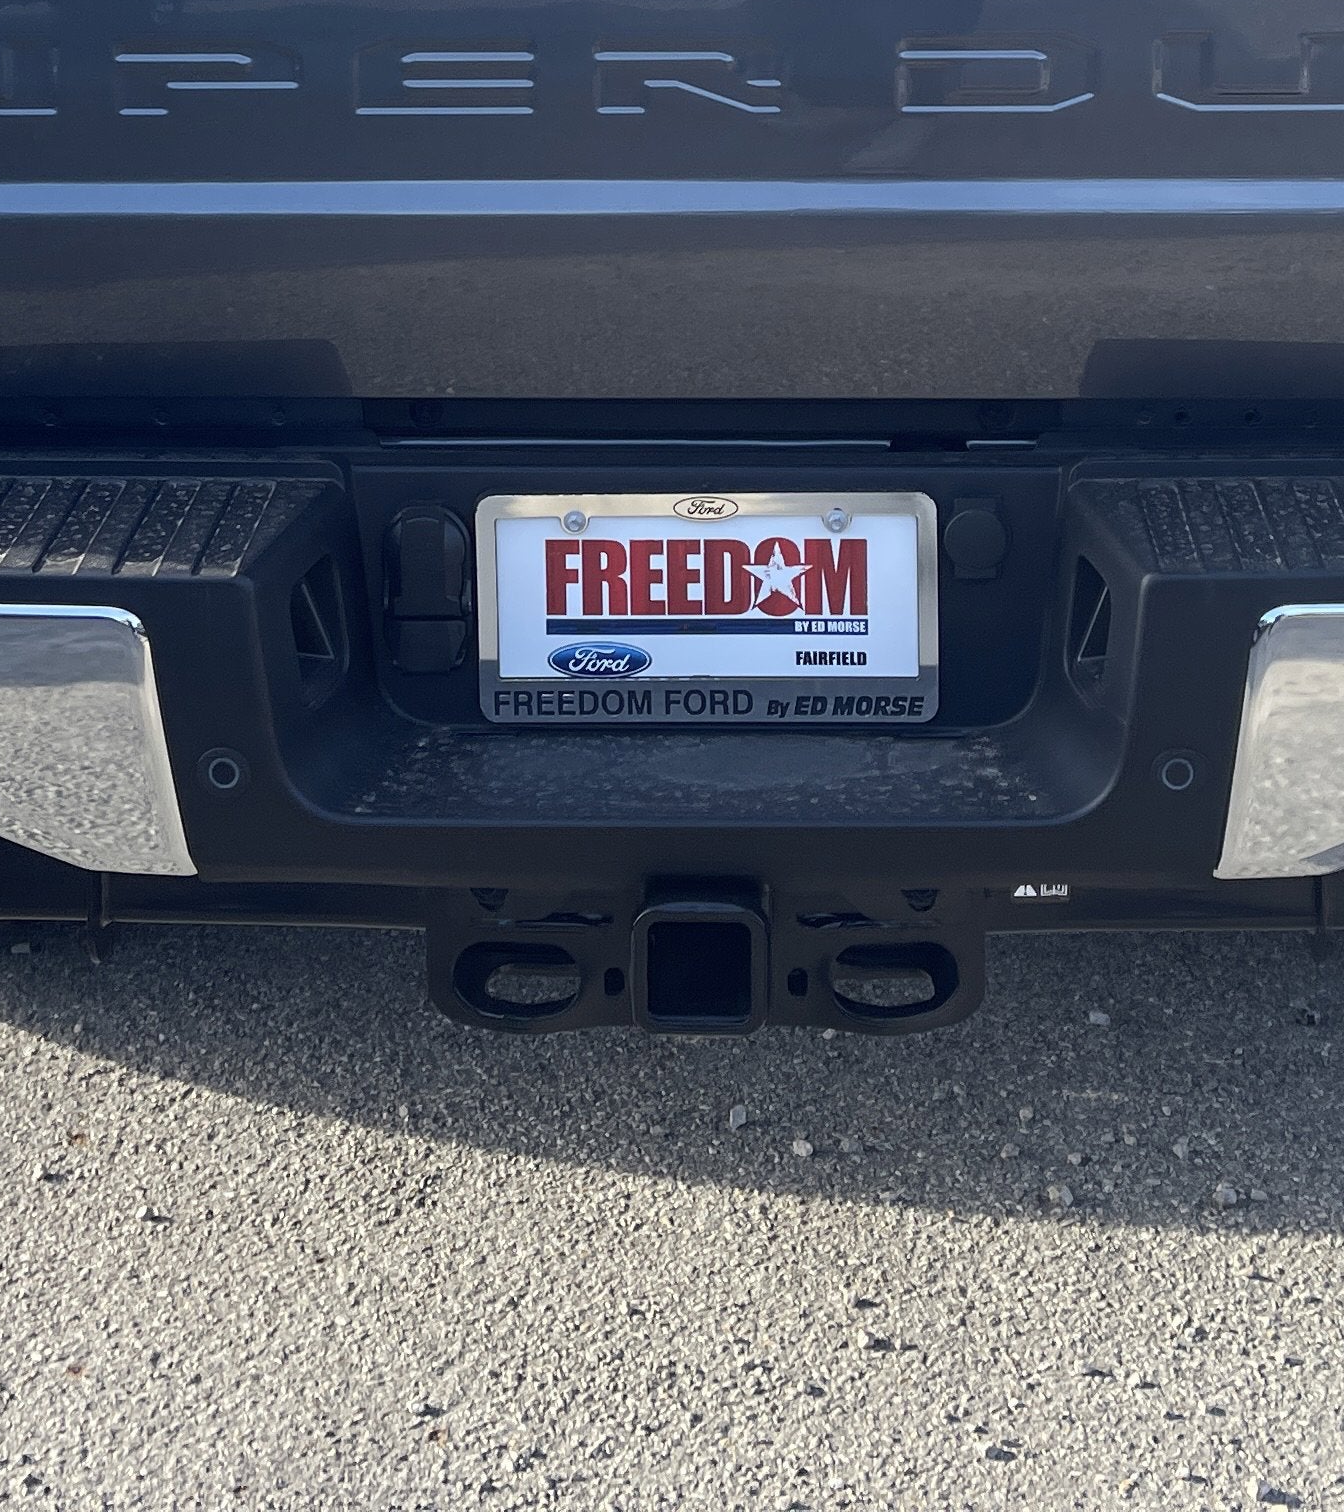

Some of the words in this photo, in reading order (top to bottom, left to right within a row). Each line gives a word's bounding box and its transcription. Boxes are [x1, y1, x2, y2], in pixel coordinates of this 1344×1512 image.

[687, 499, 725, 515] Ford
[545, 537, 869, 617] FREEDOM
[794, 620, 809, 633] BY
[811, 620, 826, 633] ED
[827, 620, 867, 633] MORSE
[568, 645, 631, 674] Ford
[795, 651, 867, 666] FAIRFIELD
[494, 690, 653, 717] FREEDOM
[664, 689, 753, 715] FORD
[767, 699, 789, 718] By
[794, 696, 832, 716] ED
[832, 696, 925, 716] MORSE
